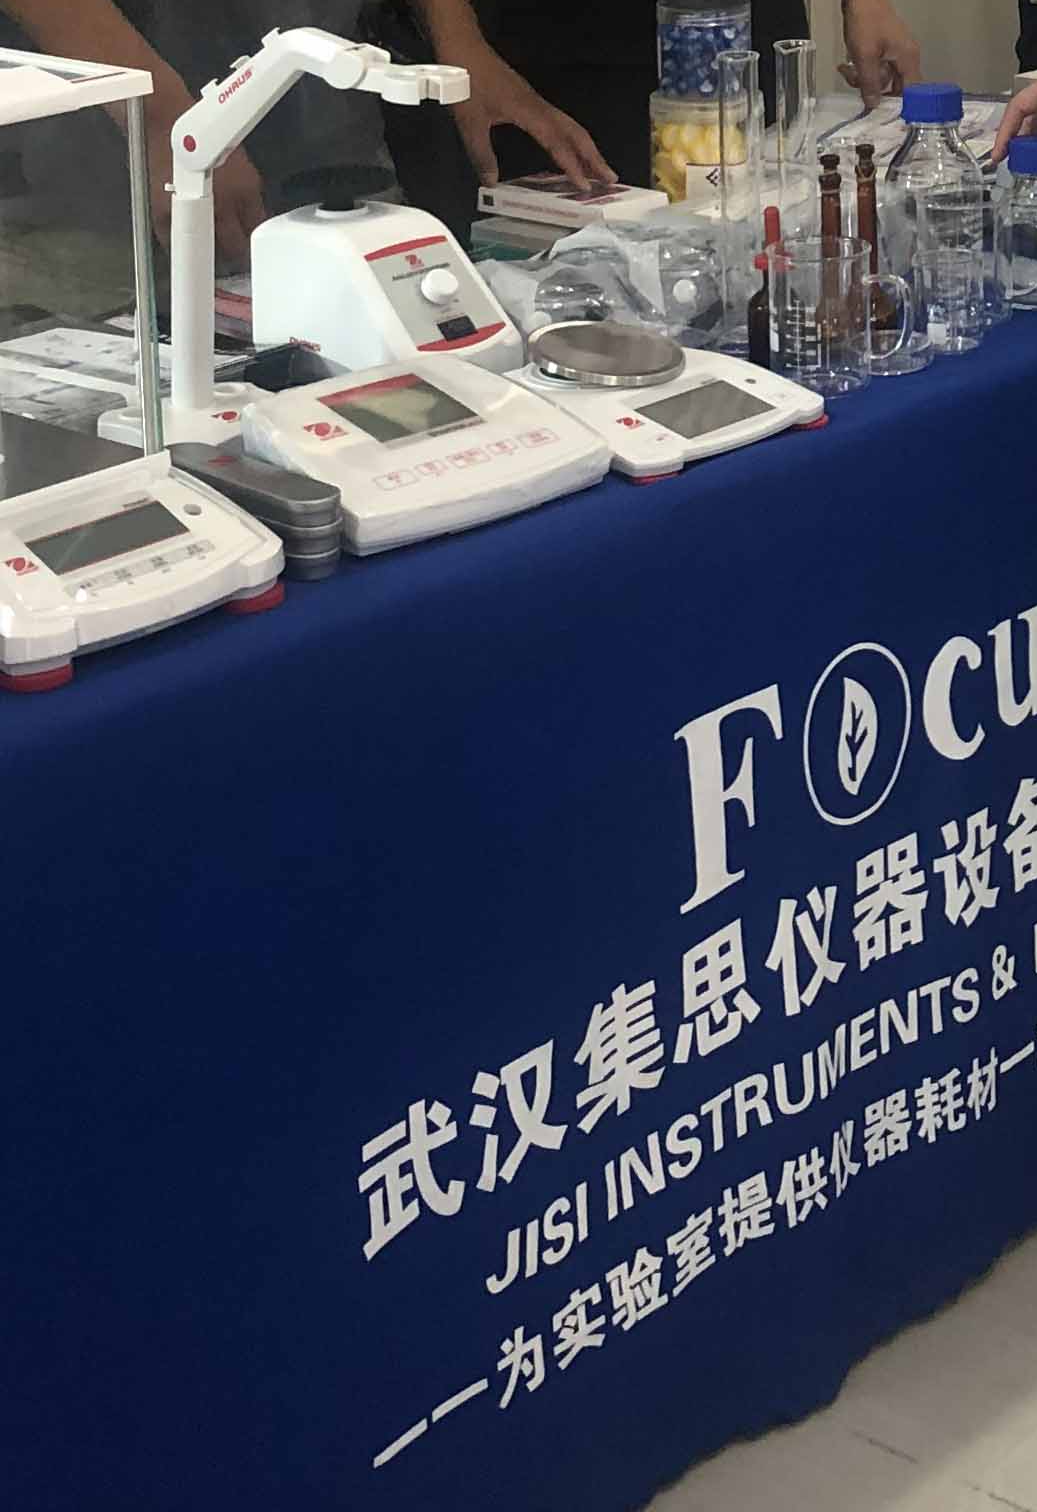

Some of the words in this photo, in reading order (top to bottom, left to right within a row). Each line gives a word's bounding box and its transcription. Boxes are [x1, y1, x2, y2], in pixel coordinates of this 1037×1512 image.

[218, 67, 253, 104] OHAUS
[486, 1181, 589, 1294] JISI
[604, 967, 980, 1221] INSTRUMENTS
[991, 944, 1017, 1001] &
